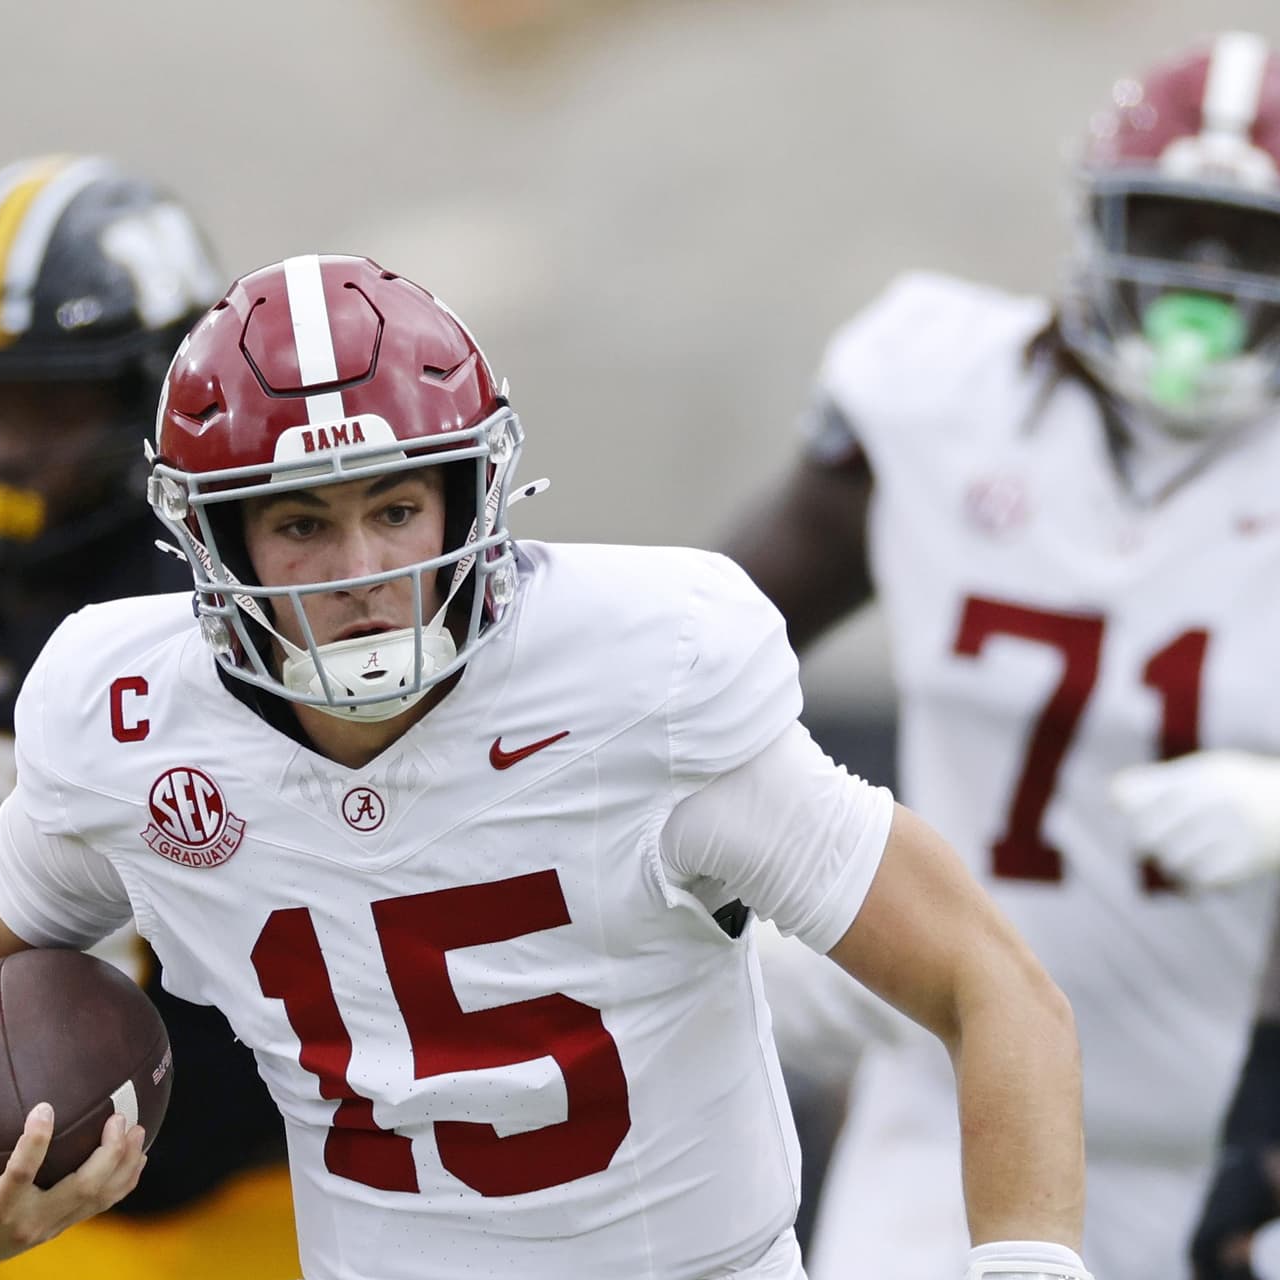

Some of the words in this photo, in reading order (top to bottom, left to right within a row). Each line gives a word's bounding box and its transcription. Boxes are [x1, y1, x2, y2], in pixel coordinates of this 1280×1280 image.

[302, 422, 365, 453] BAMA
[454, 516, 492, 583] CRISON
[109, 675, 150, 743] C
[951, 595, 1212, 896] 71
[151, 770, 220, 843] SEC
[158, 834, 236, 866] GRADUATE
[250, 868, 631, 1198] 15
